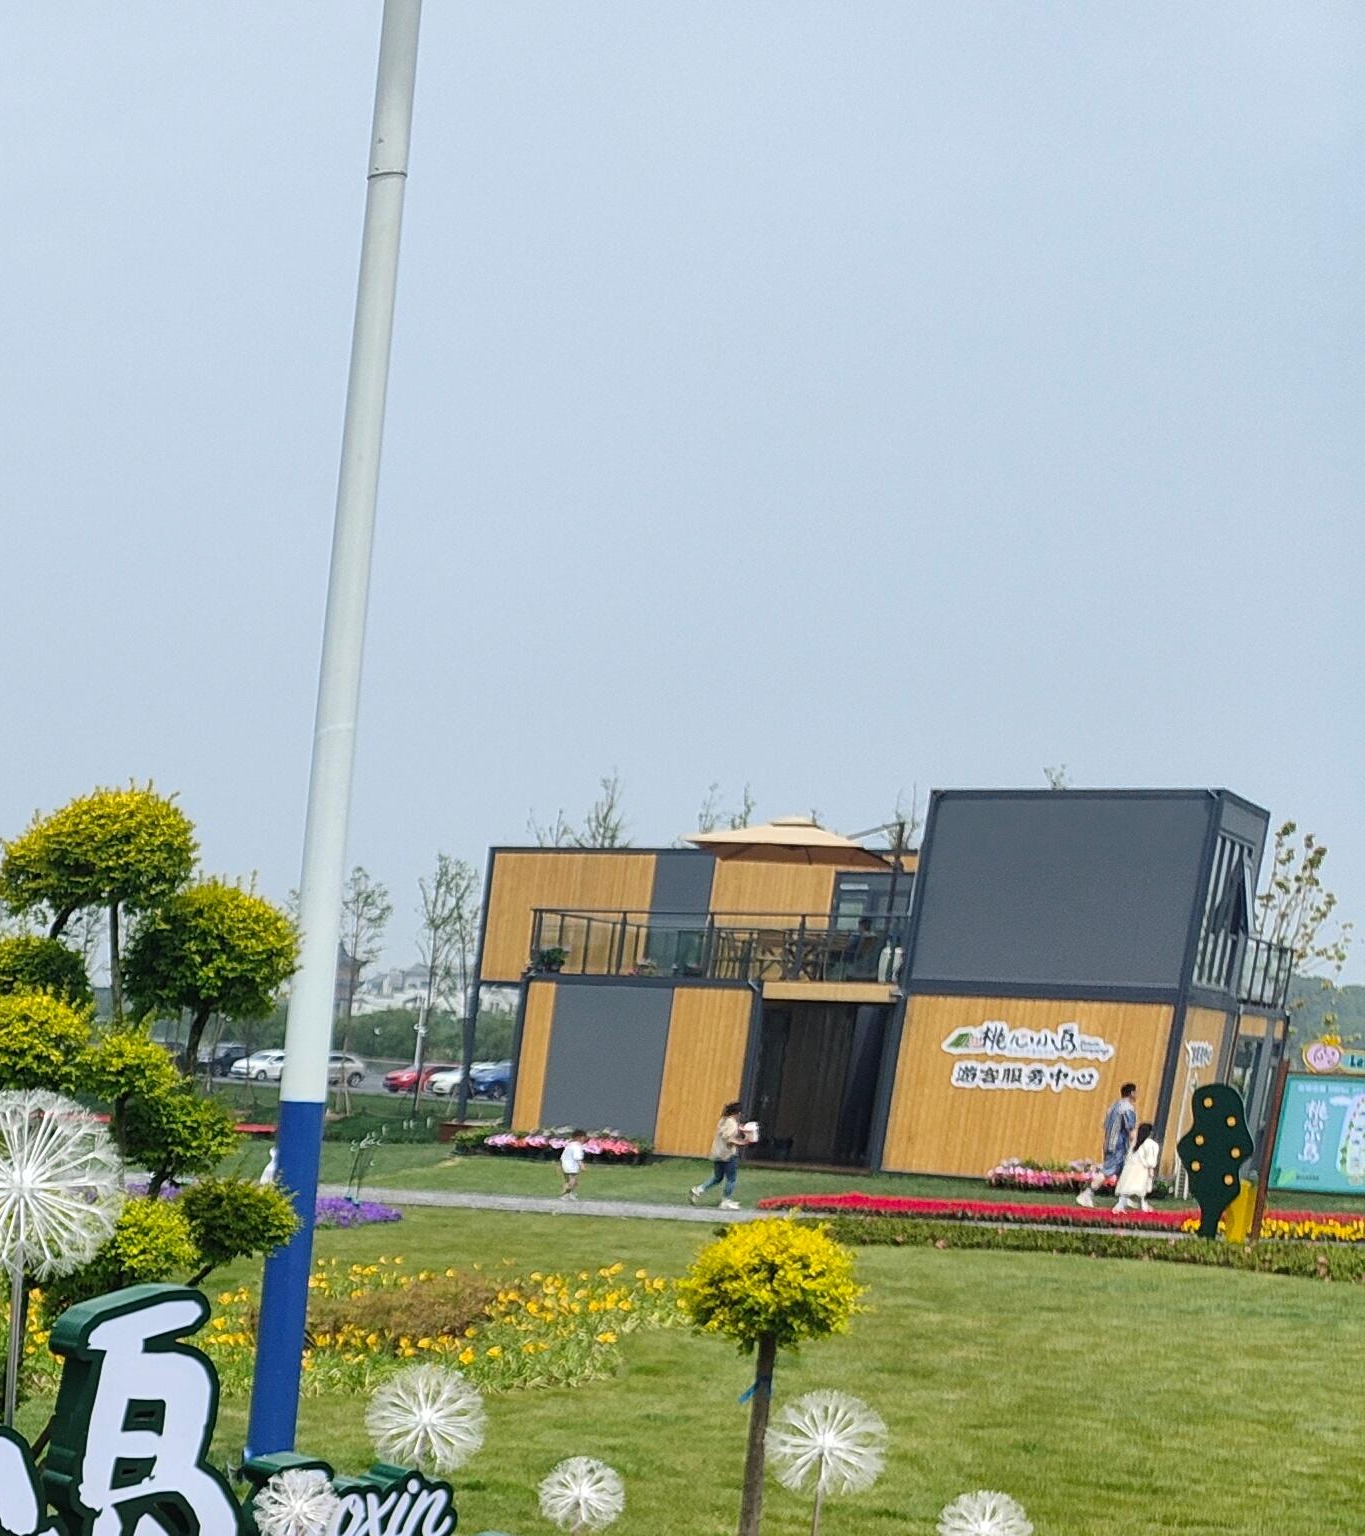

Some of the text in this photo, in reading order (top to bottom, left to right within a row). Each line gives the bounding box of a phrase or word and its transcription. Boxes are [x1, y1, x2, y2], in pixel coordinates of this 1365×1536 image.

[983, 1025, 1078, 1053] 桃心小岛
[955, 1065, 1095, 1087] 游客服务中心
